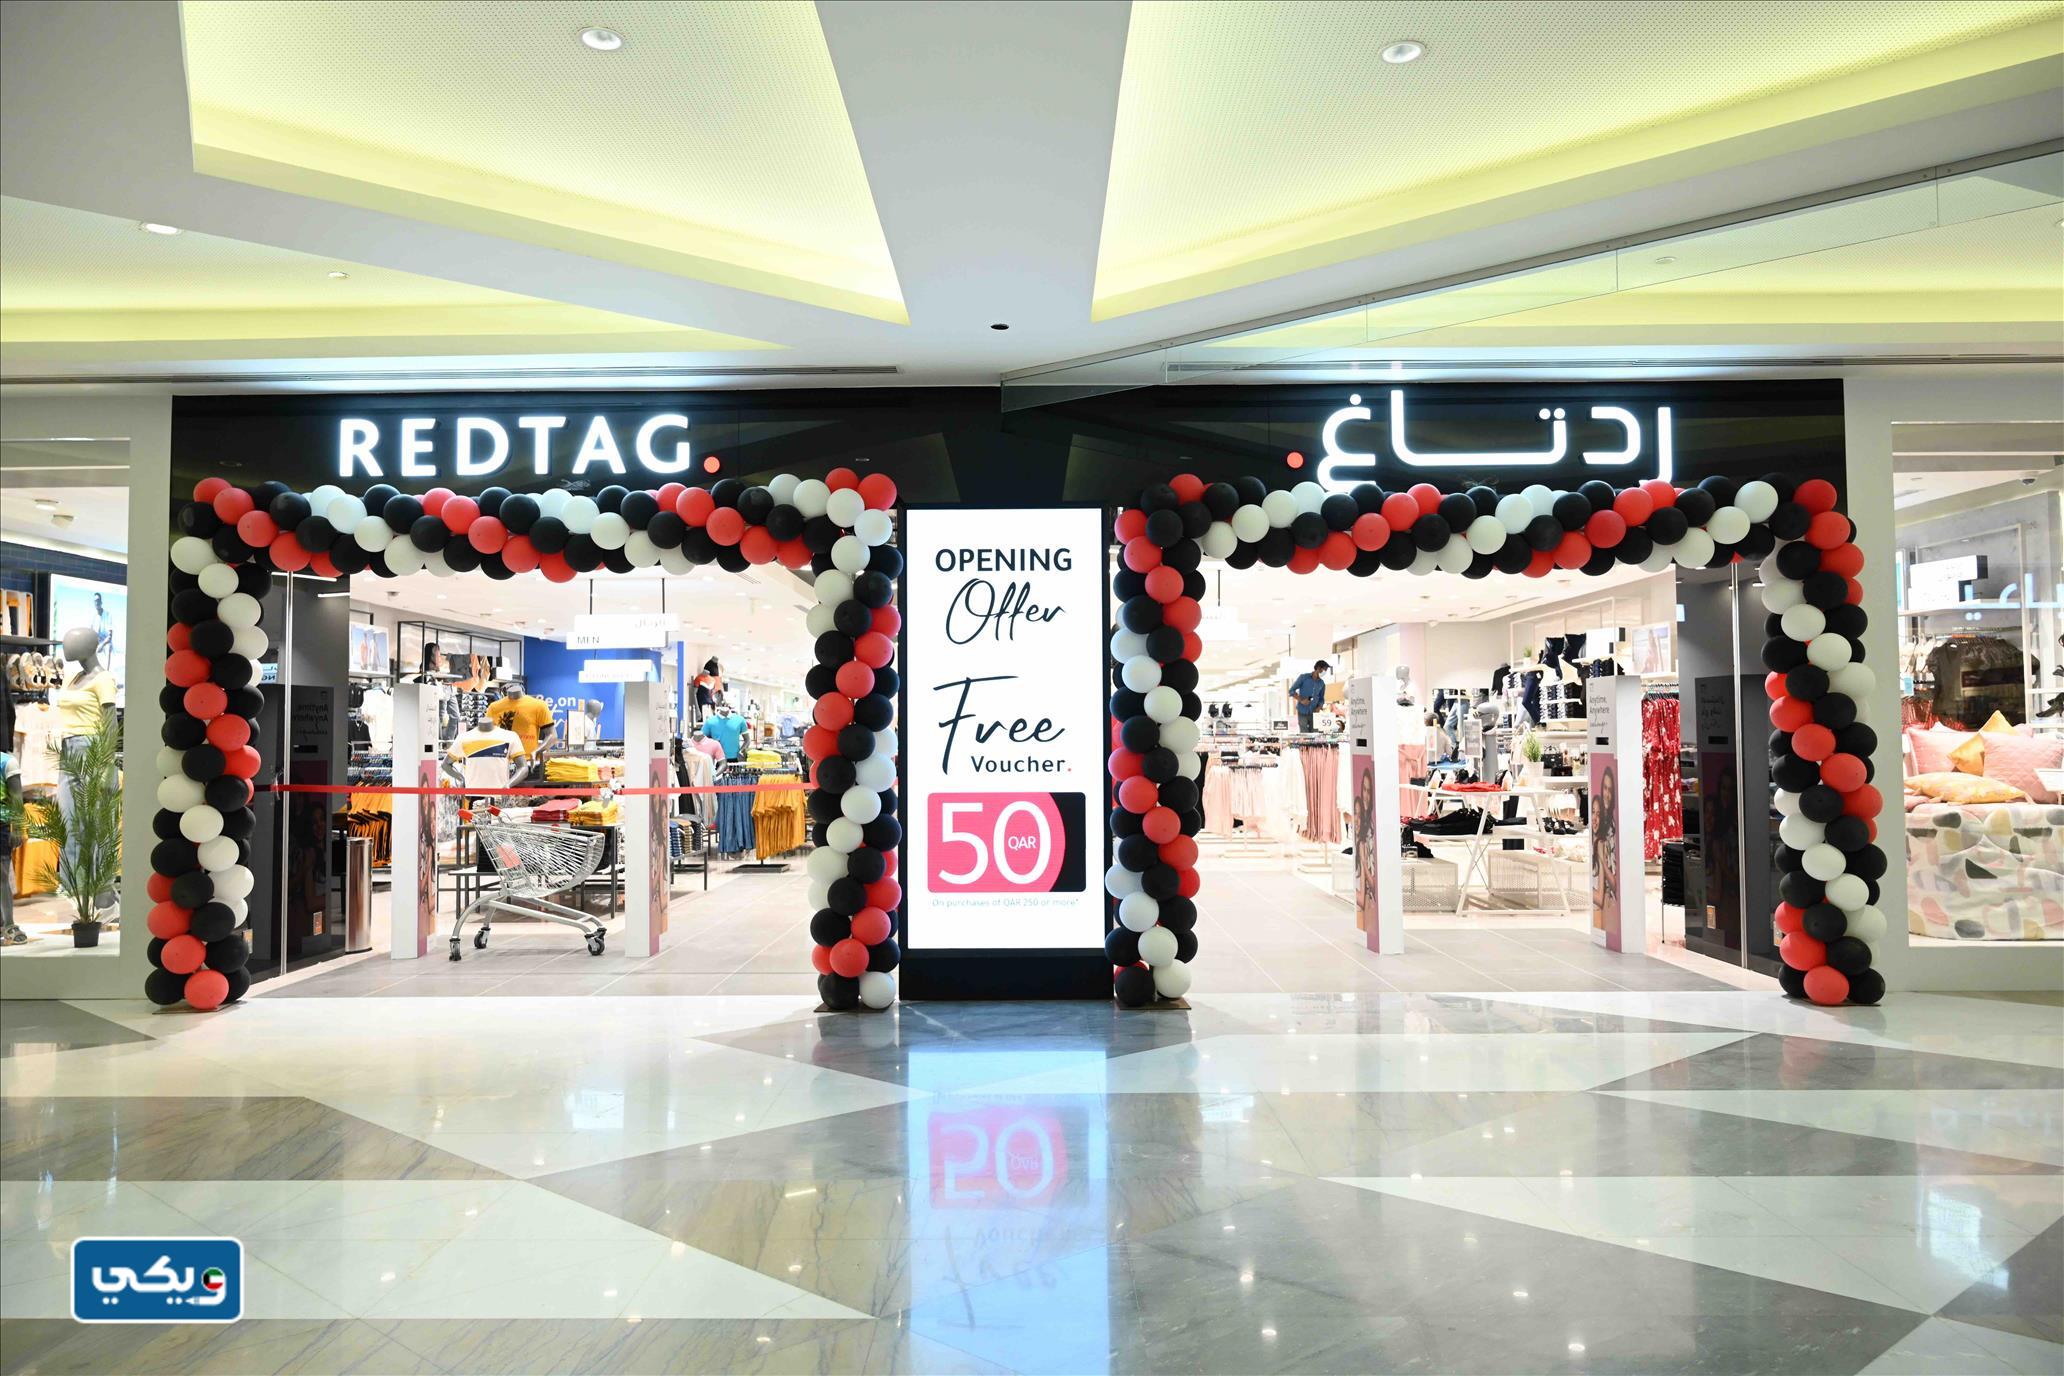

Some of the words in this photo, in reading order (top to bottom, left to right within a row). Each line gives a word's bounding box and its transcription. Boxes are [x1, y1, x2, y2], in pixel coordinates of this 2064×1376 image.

[935, 548, 1073, 572] OPENING
[945, 577, 1066, 645] Offer
[576, 635, 601, 645] MEN
[557, 696, 577, 708] on
[932, 675, 1066, 775] Free
[1322, 719, 1332, 727] 59
[937, 801, 1052, 886] 50
[1008, 836, 1037, 850] QAR
[932, 898, 945, 907] On
[946, 898, 990, 909] purchases
[992, 898, 1002, 907] of
[1003, 898, 1021, 908] QAR
[1023, 898, 1039, 907] 250
[1040, 899, 1050, 907] or
